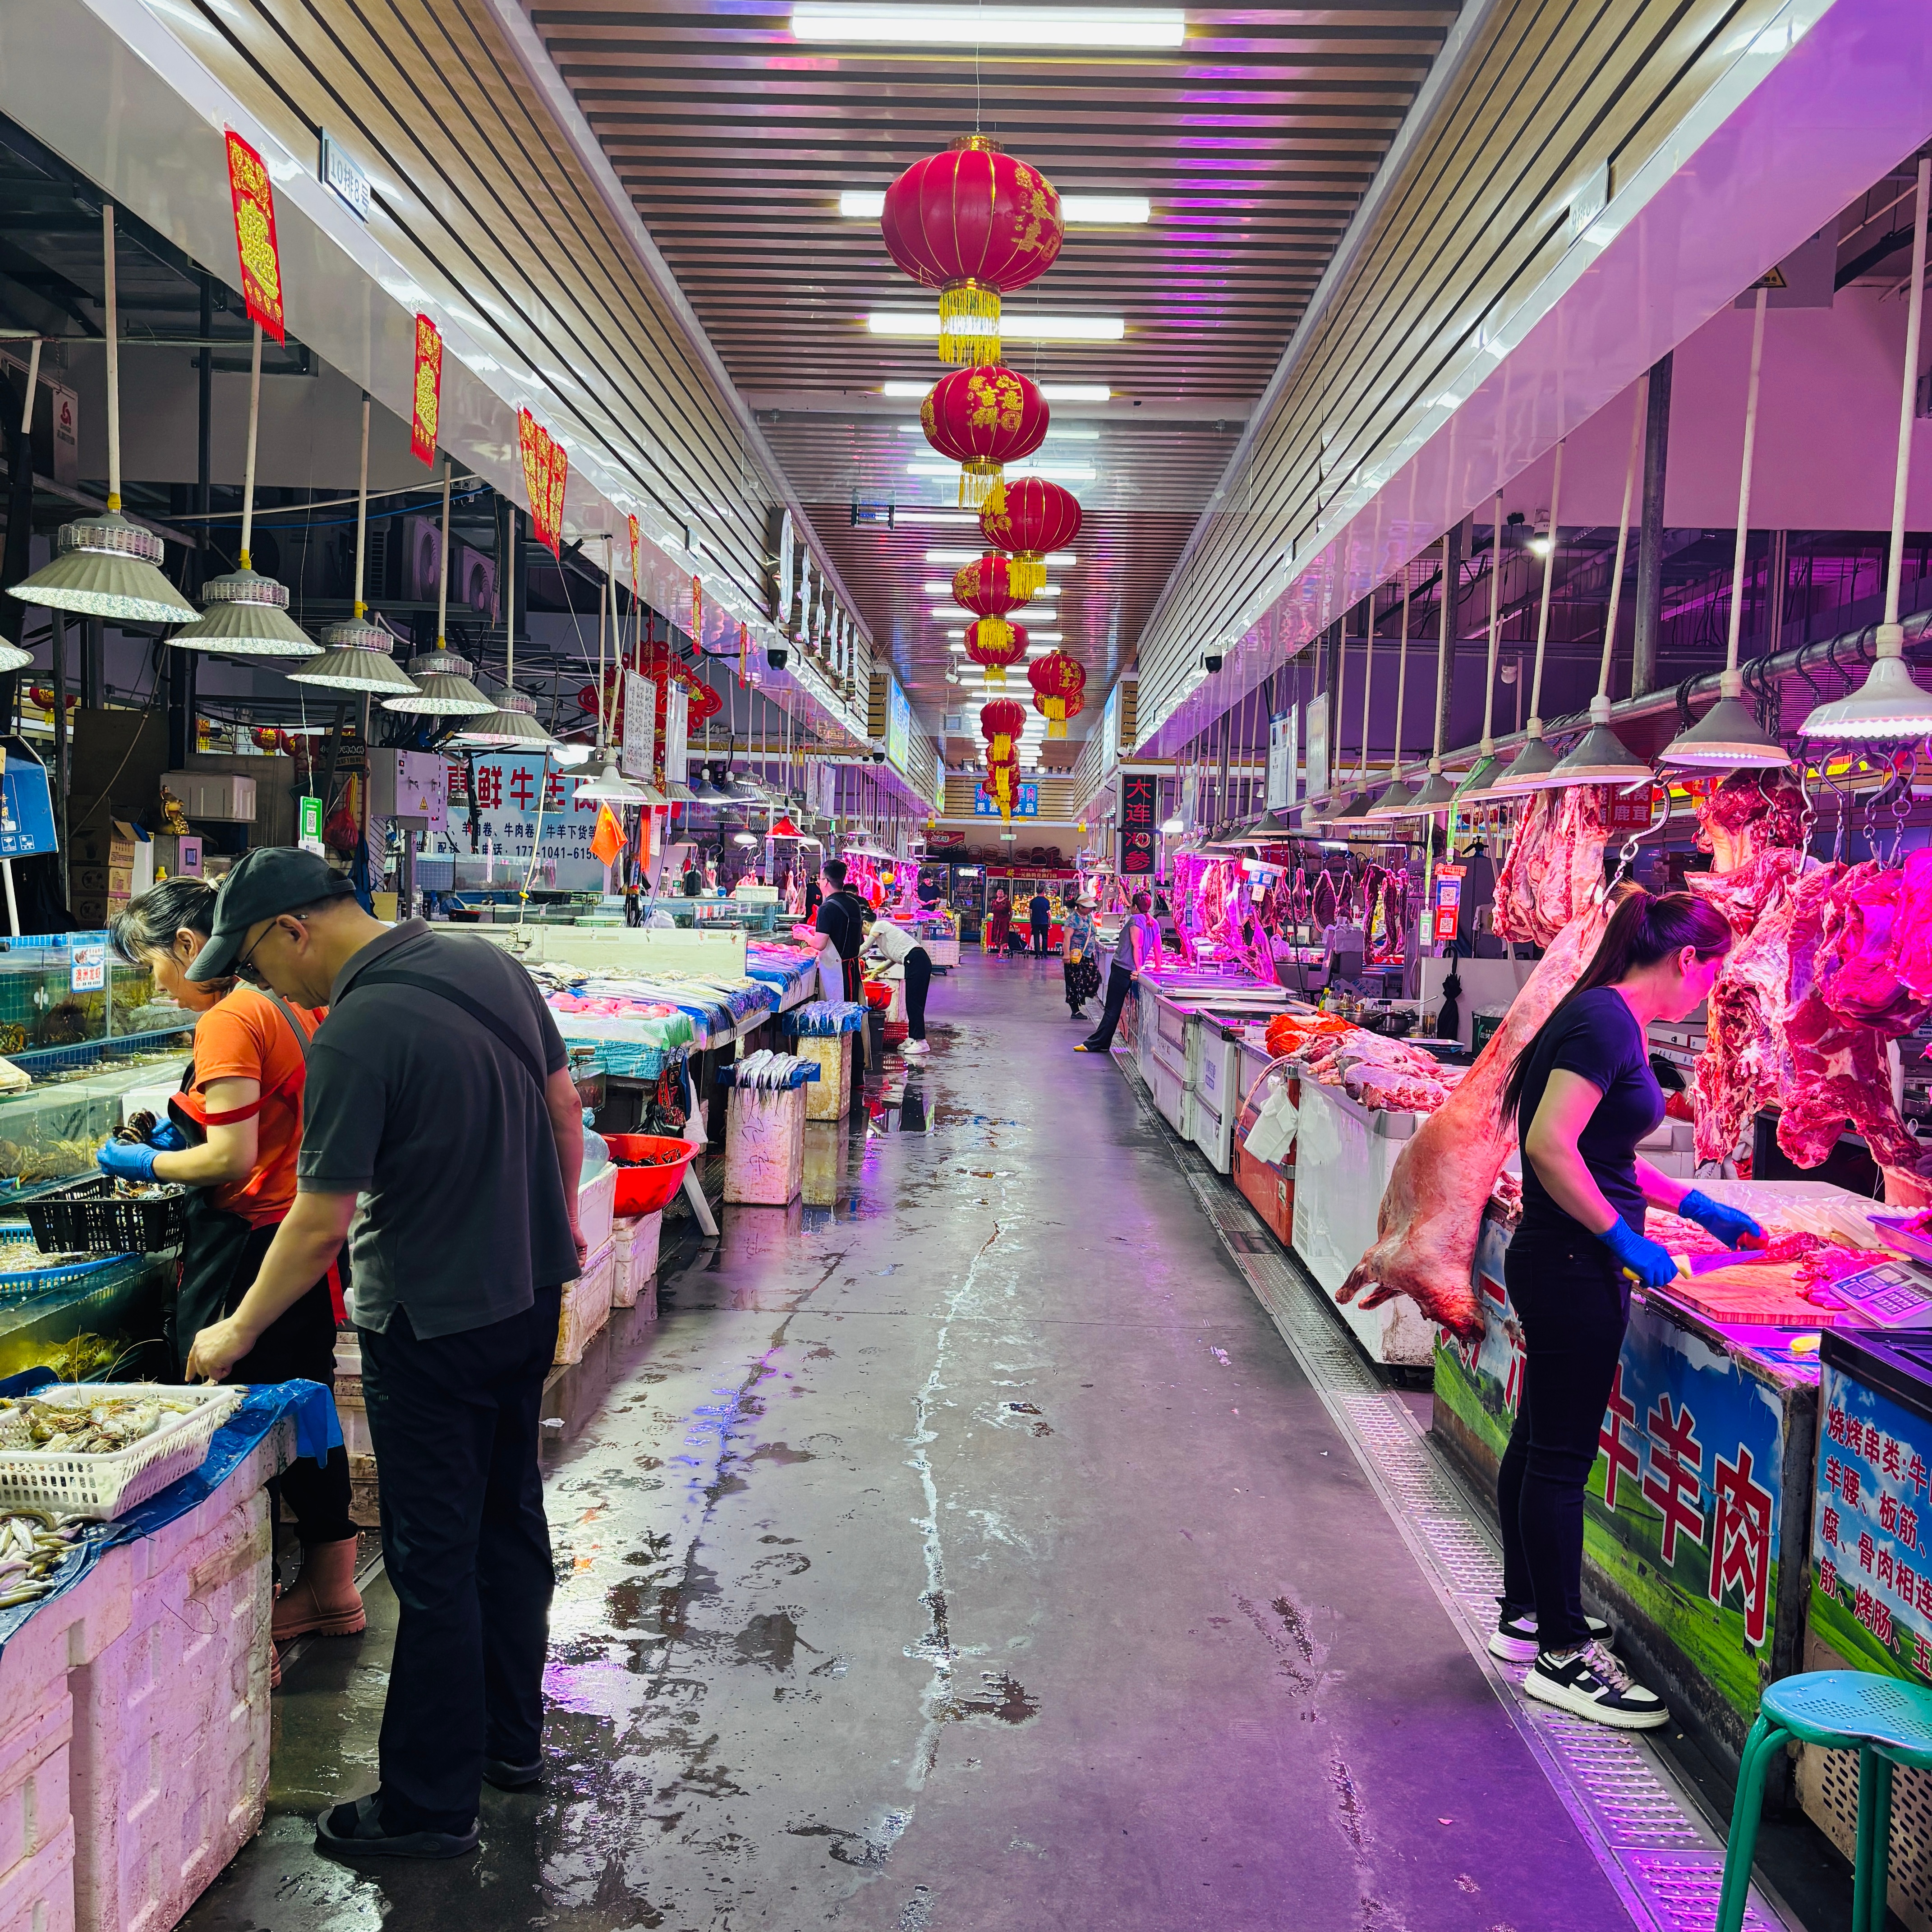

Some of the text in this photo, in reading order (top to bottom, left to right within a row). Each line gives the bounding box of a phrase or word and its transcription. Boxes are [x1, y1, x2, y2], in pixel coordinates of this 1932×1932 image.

[331, 153, 369, 215] 10排8号
[1126, 779, 1151, 871] 大连海参
[1614, 805, 1649, 822] 鹿茸
[1827, 1402, 1932, 1504] 烧烤串类:牛
